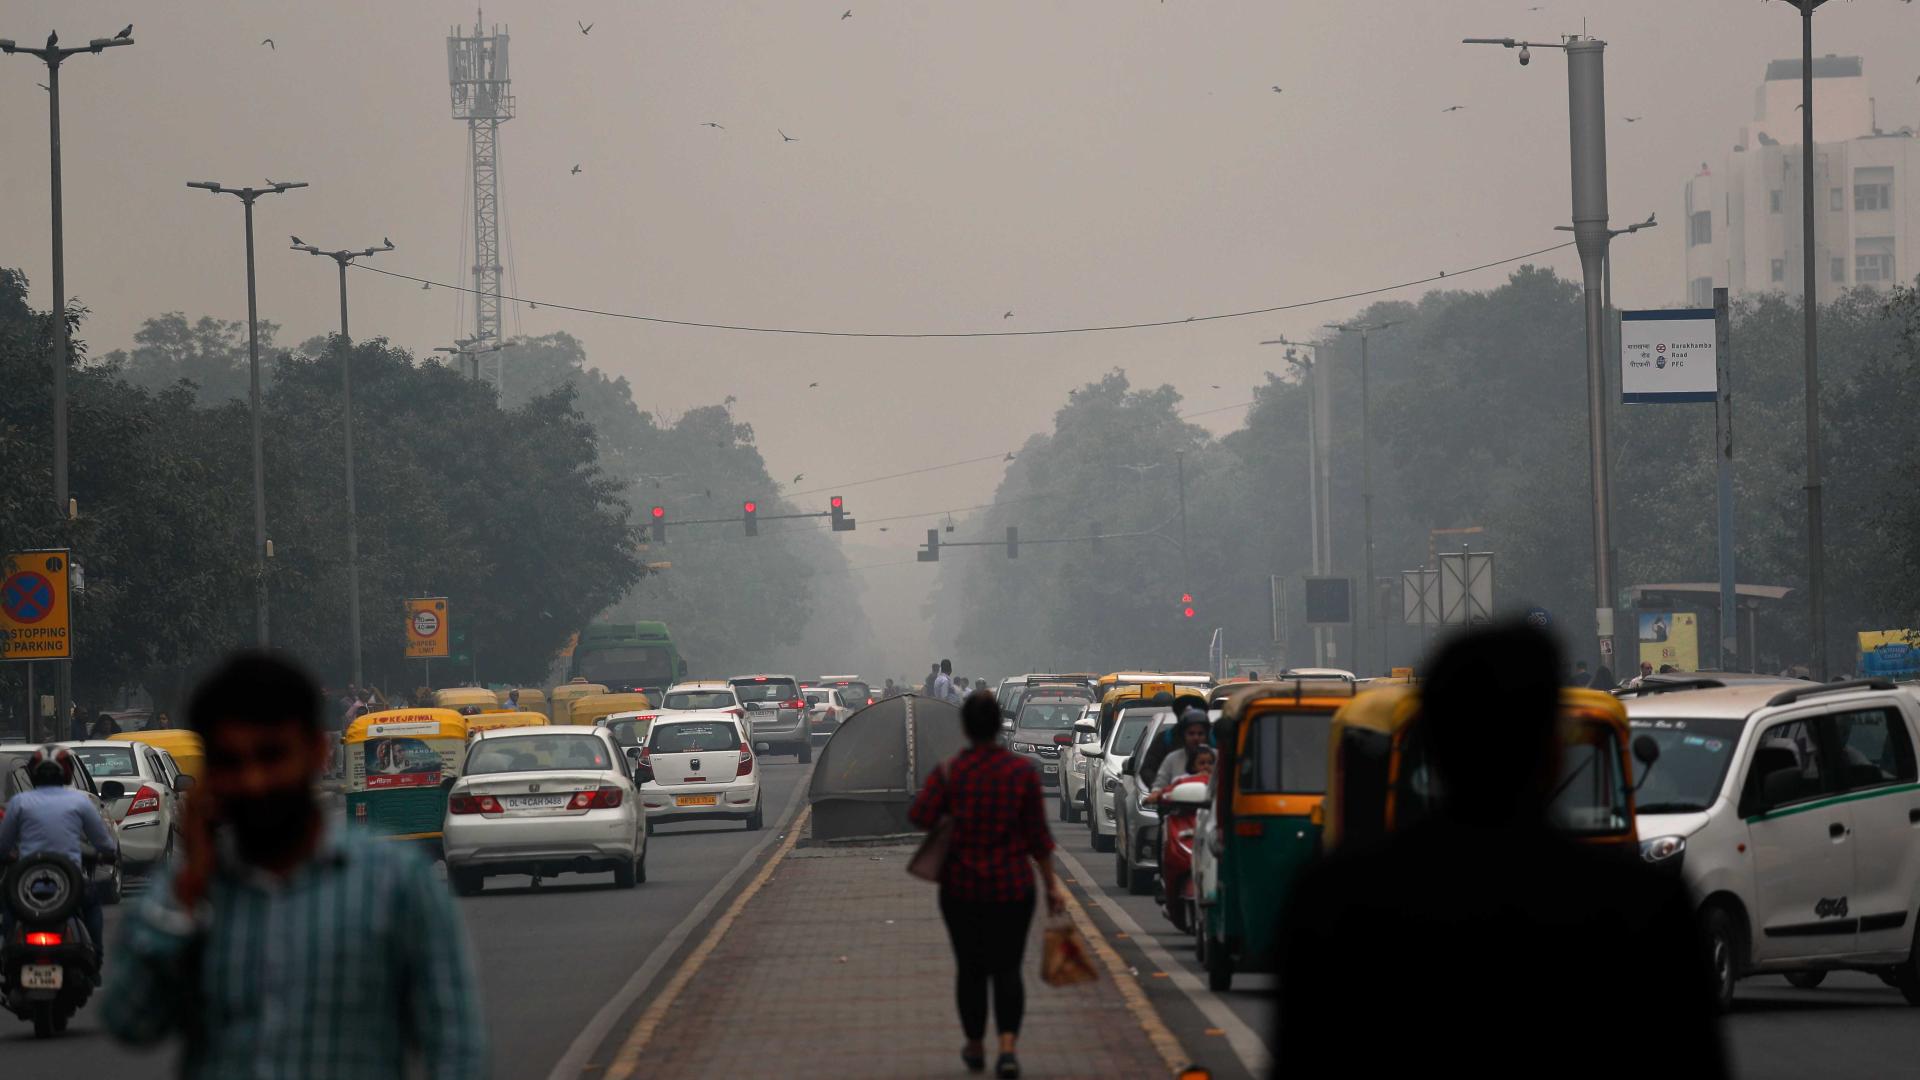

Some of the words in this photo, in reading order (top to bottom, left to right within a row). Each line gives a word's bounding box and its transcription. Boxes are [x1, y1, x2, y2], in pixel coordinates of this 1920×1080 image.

[11, 627, 66, 639] STOPPING
[14, 641, 63, 652] PARKING
[389, 715, 434, 723] KEJRIWAL
